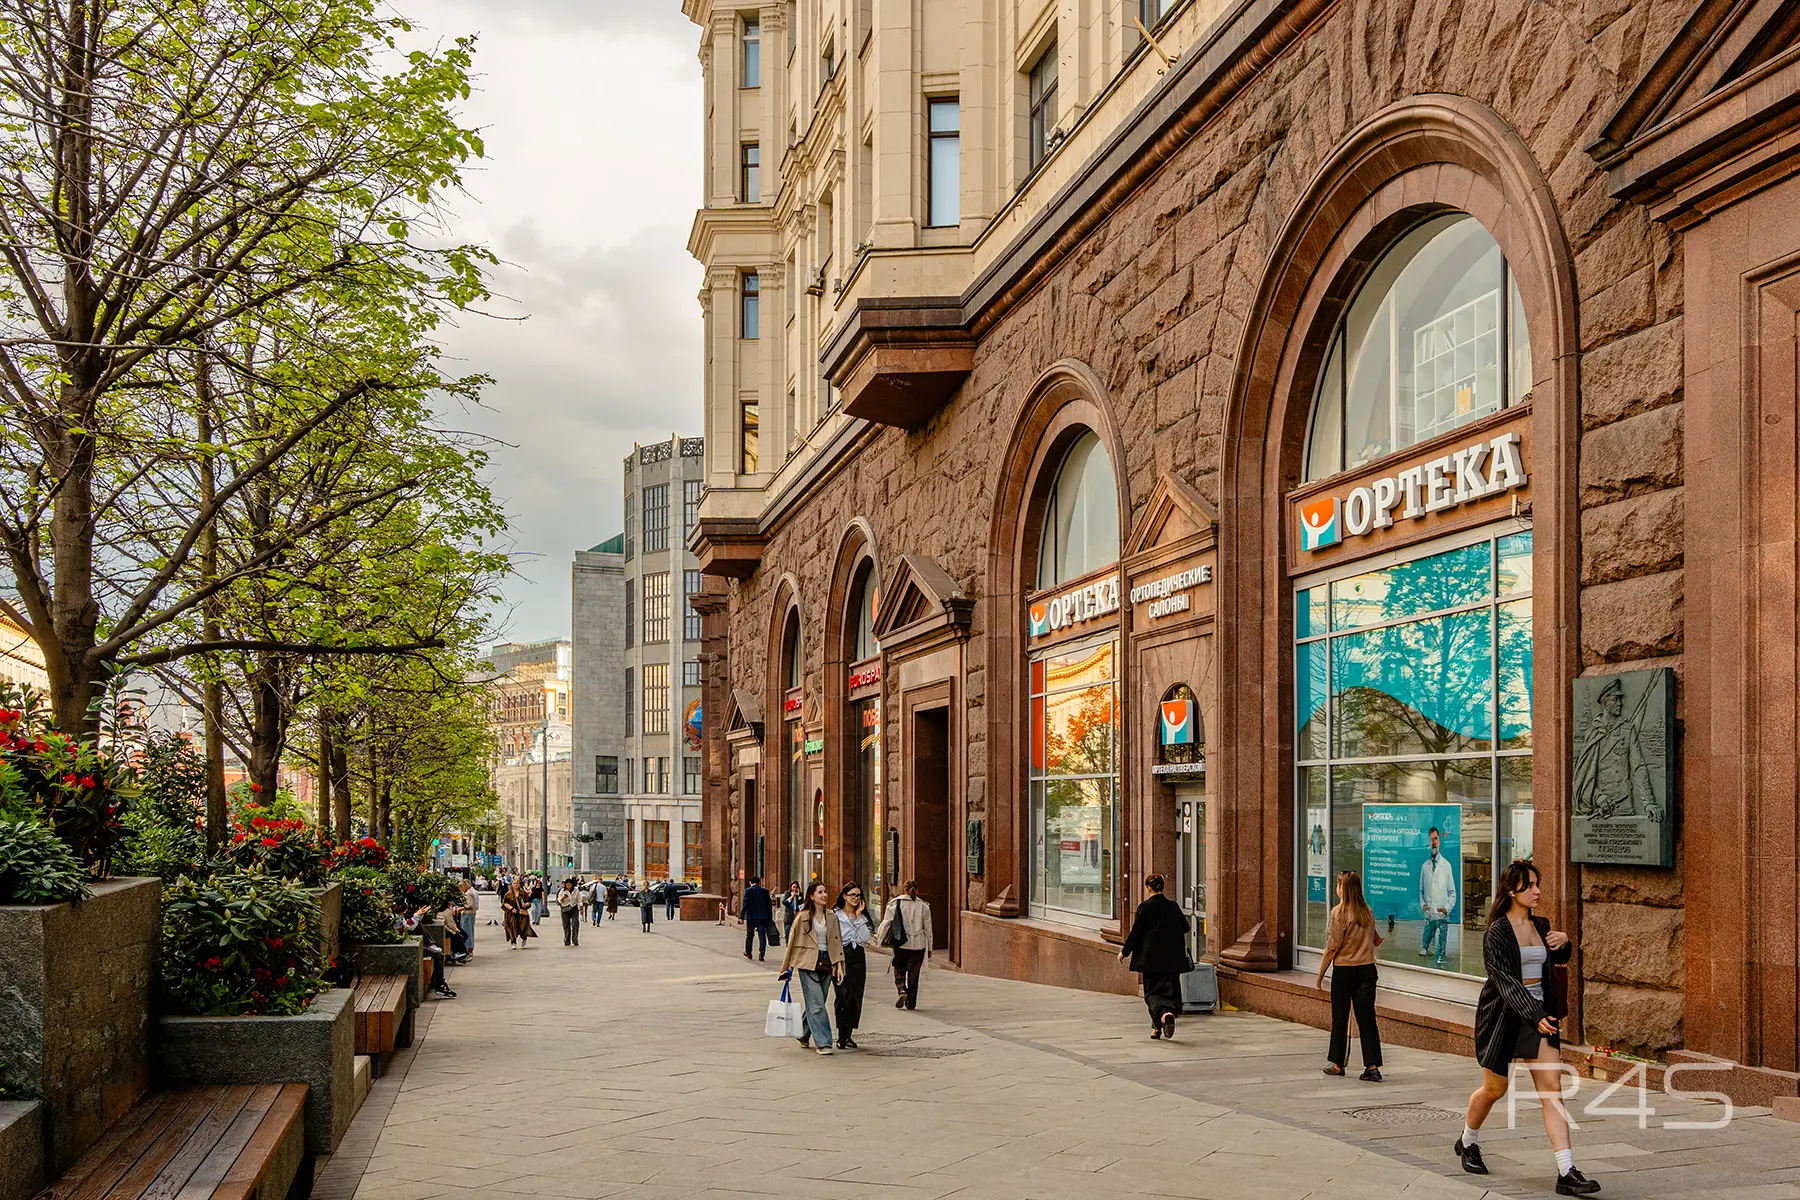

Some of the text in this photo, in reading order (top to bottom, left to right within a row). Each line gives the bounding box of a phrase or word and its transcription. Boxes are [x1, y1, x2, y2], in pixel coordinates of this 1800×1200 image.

[1345, 432, 1526, 536] ОРТЕКА
[1050, 576, 1120, 631] ОРТЕКА
[1130, 565, 1211, 604] ОРТОПЕДИЧЕСКИЕ
[1148, 594, 1190, 619] САЛОНЫ
